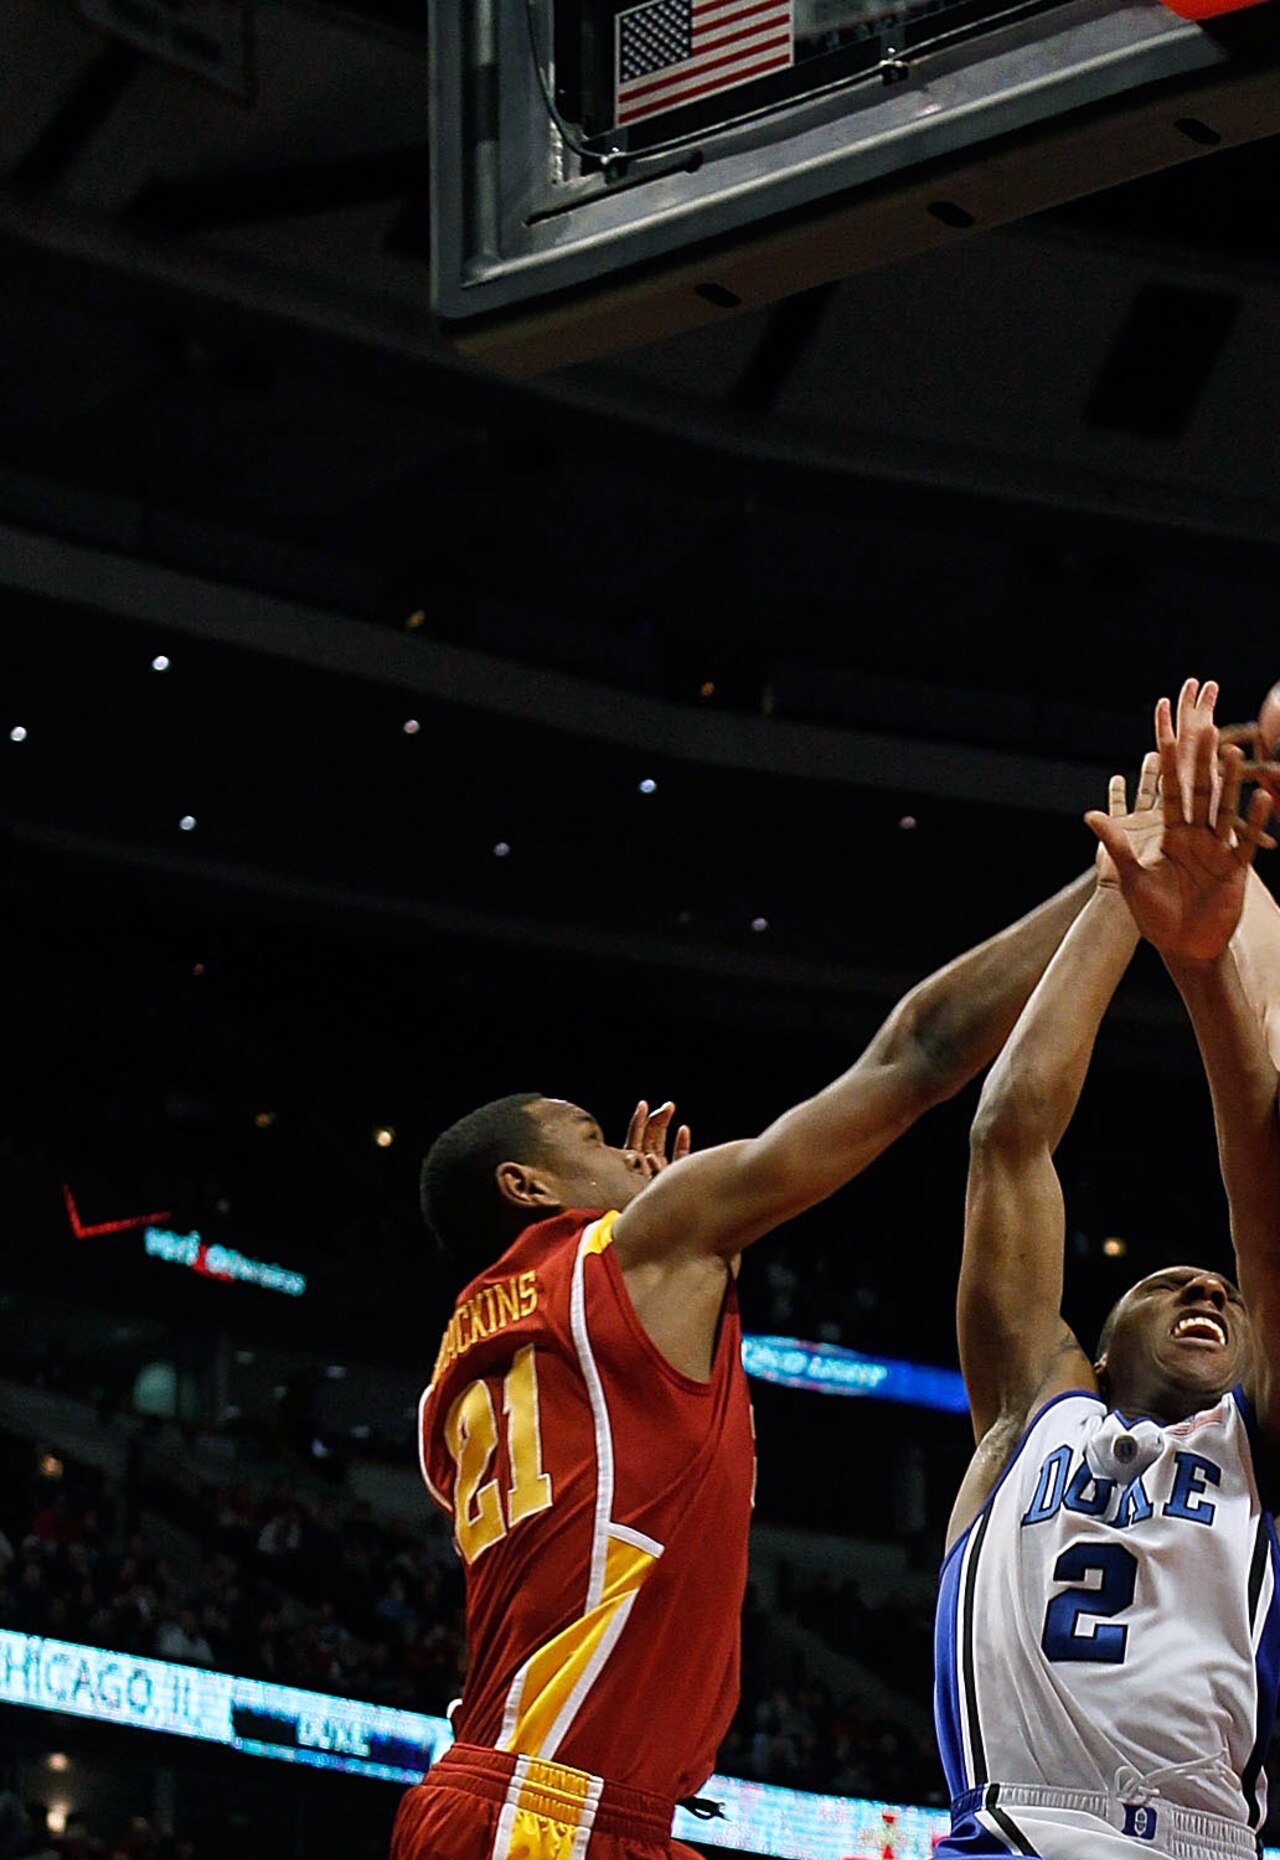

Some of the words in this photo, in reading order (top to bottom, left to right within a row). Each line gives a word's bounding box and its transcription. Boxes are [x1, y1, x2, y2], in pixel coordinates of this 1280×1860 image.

[445, 1343, 553, 1555] 21
[1021, 1444, 1222, 1528] DUKE
[1041, 1542, 1138, 1664] 2
